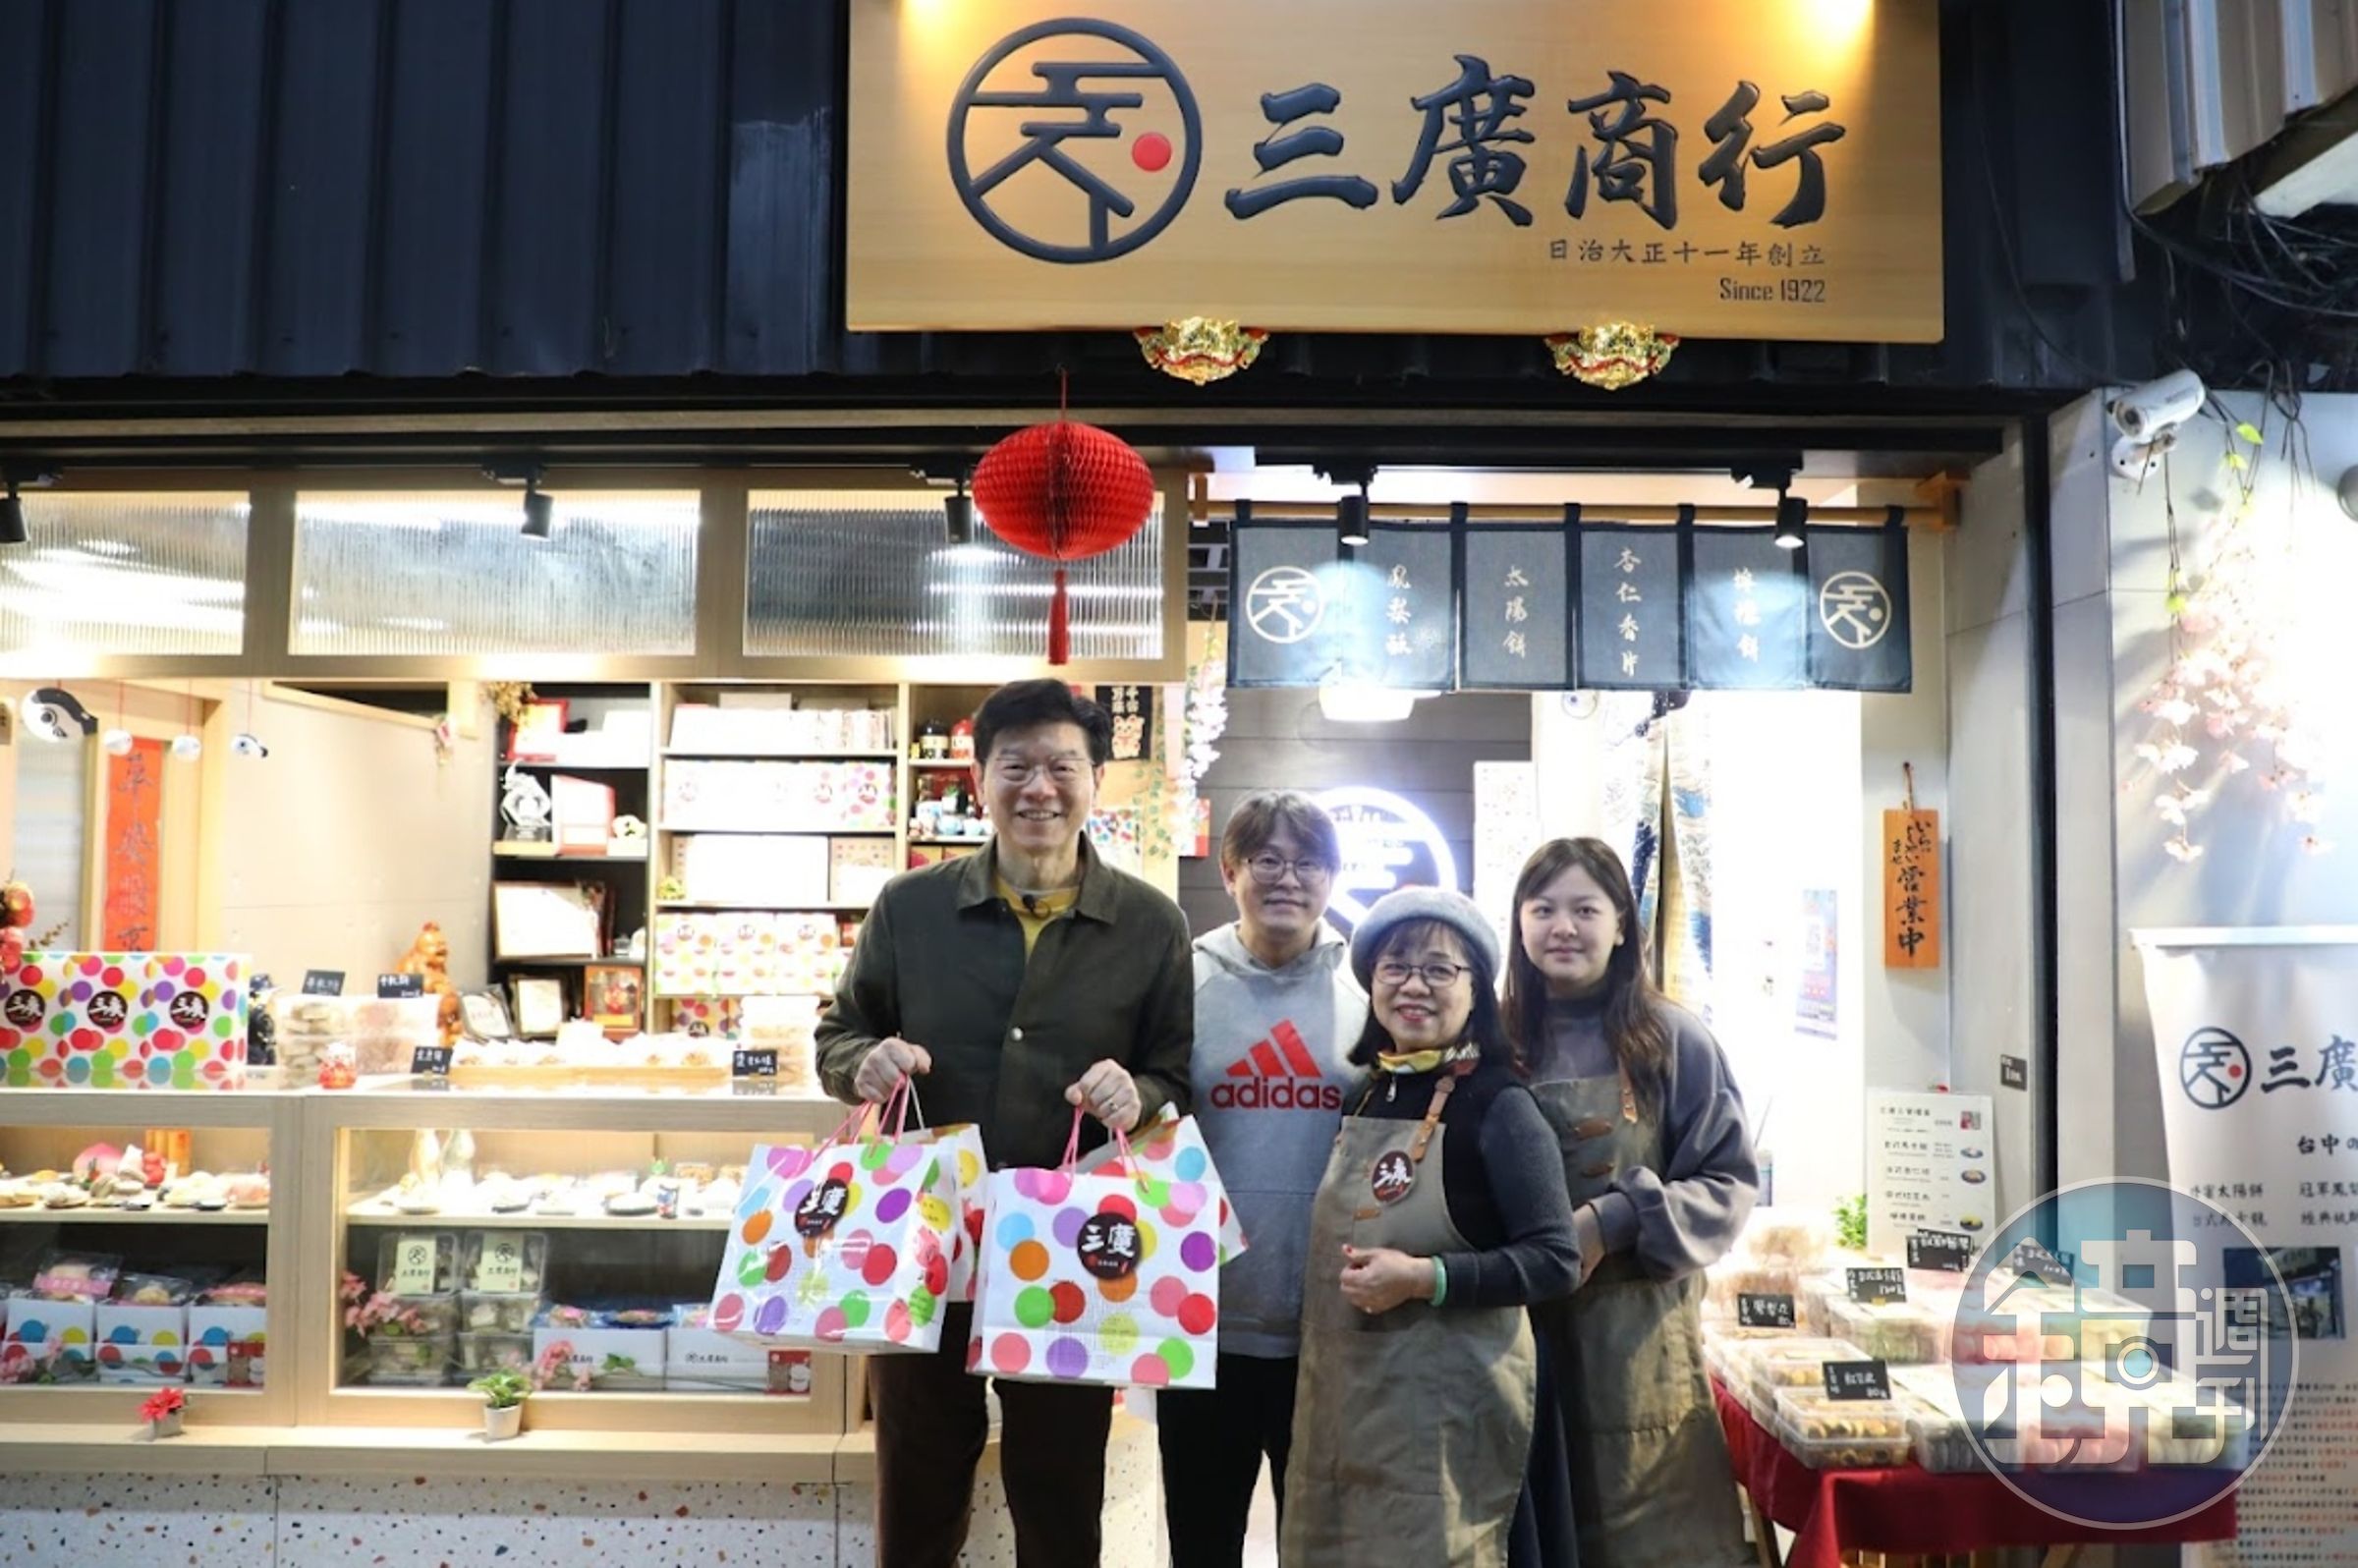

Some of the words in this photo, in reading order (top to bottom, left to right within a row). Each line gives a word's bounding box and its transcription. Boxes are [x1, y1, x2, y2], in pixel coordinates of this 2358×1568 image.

[1224, 54, 1847, 230] 三廣商行
[1549, 239, 1825, 268] 日治大正十一年創立
[1719, 277, 1773, 302] Since
[1779, 278, 1826, 304] 1922
[1502, 565, 1530, 659] 太陽餅
[2261, 1035, 2358, 1094] 三廣
[1209, 1077, 1342, 1110] adidas
[1082, 1223, 1136, 1258] 三廣
